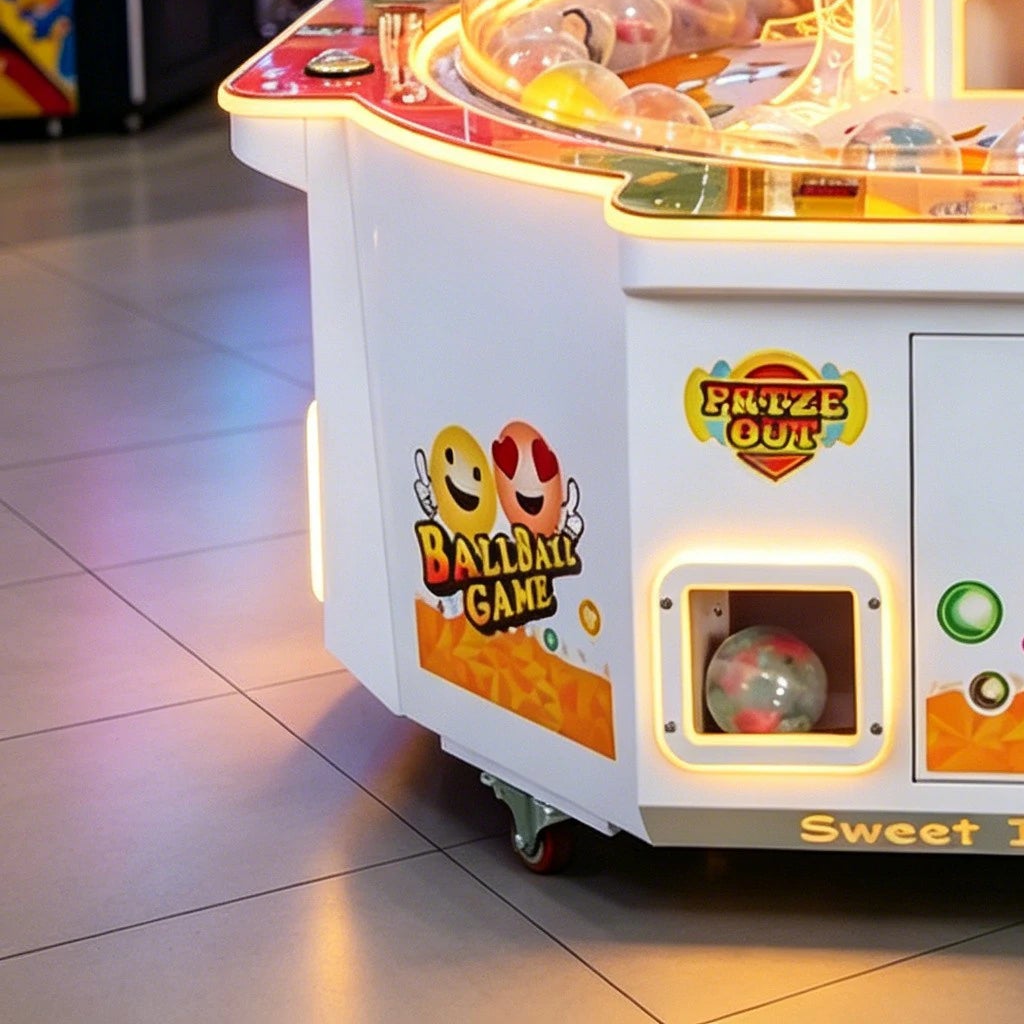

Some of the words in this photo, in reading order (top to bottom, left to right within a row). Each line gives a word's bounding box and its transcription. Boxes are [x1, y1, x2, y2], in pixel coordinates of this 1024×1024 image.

[728, 417, 819, 450] OUT
[465, 574, 556, 628] GAME
[800, 814, 981, 846] Sweet
